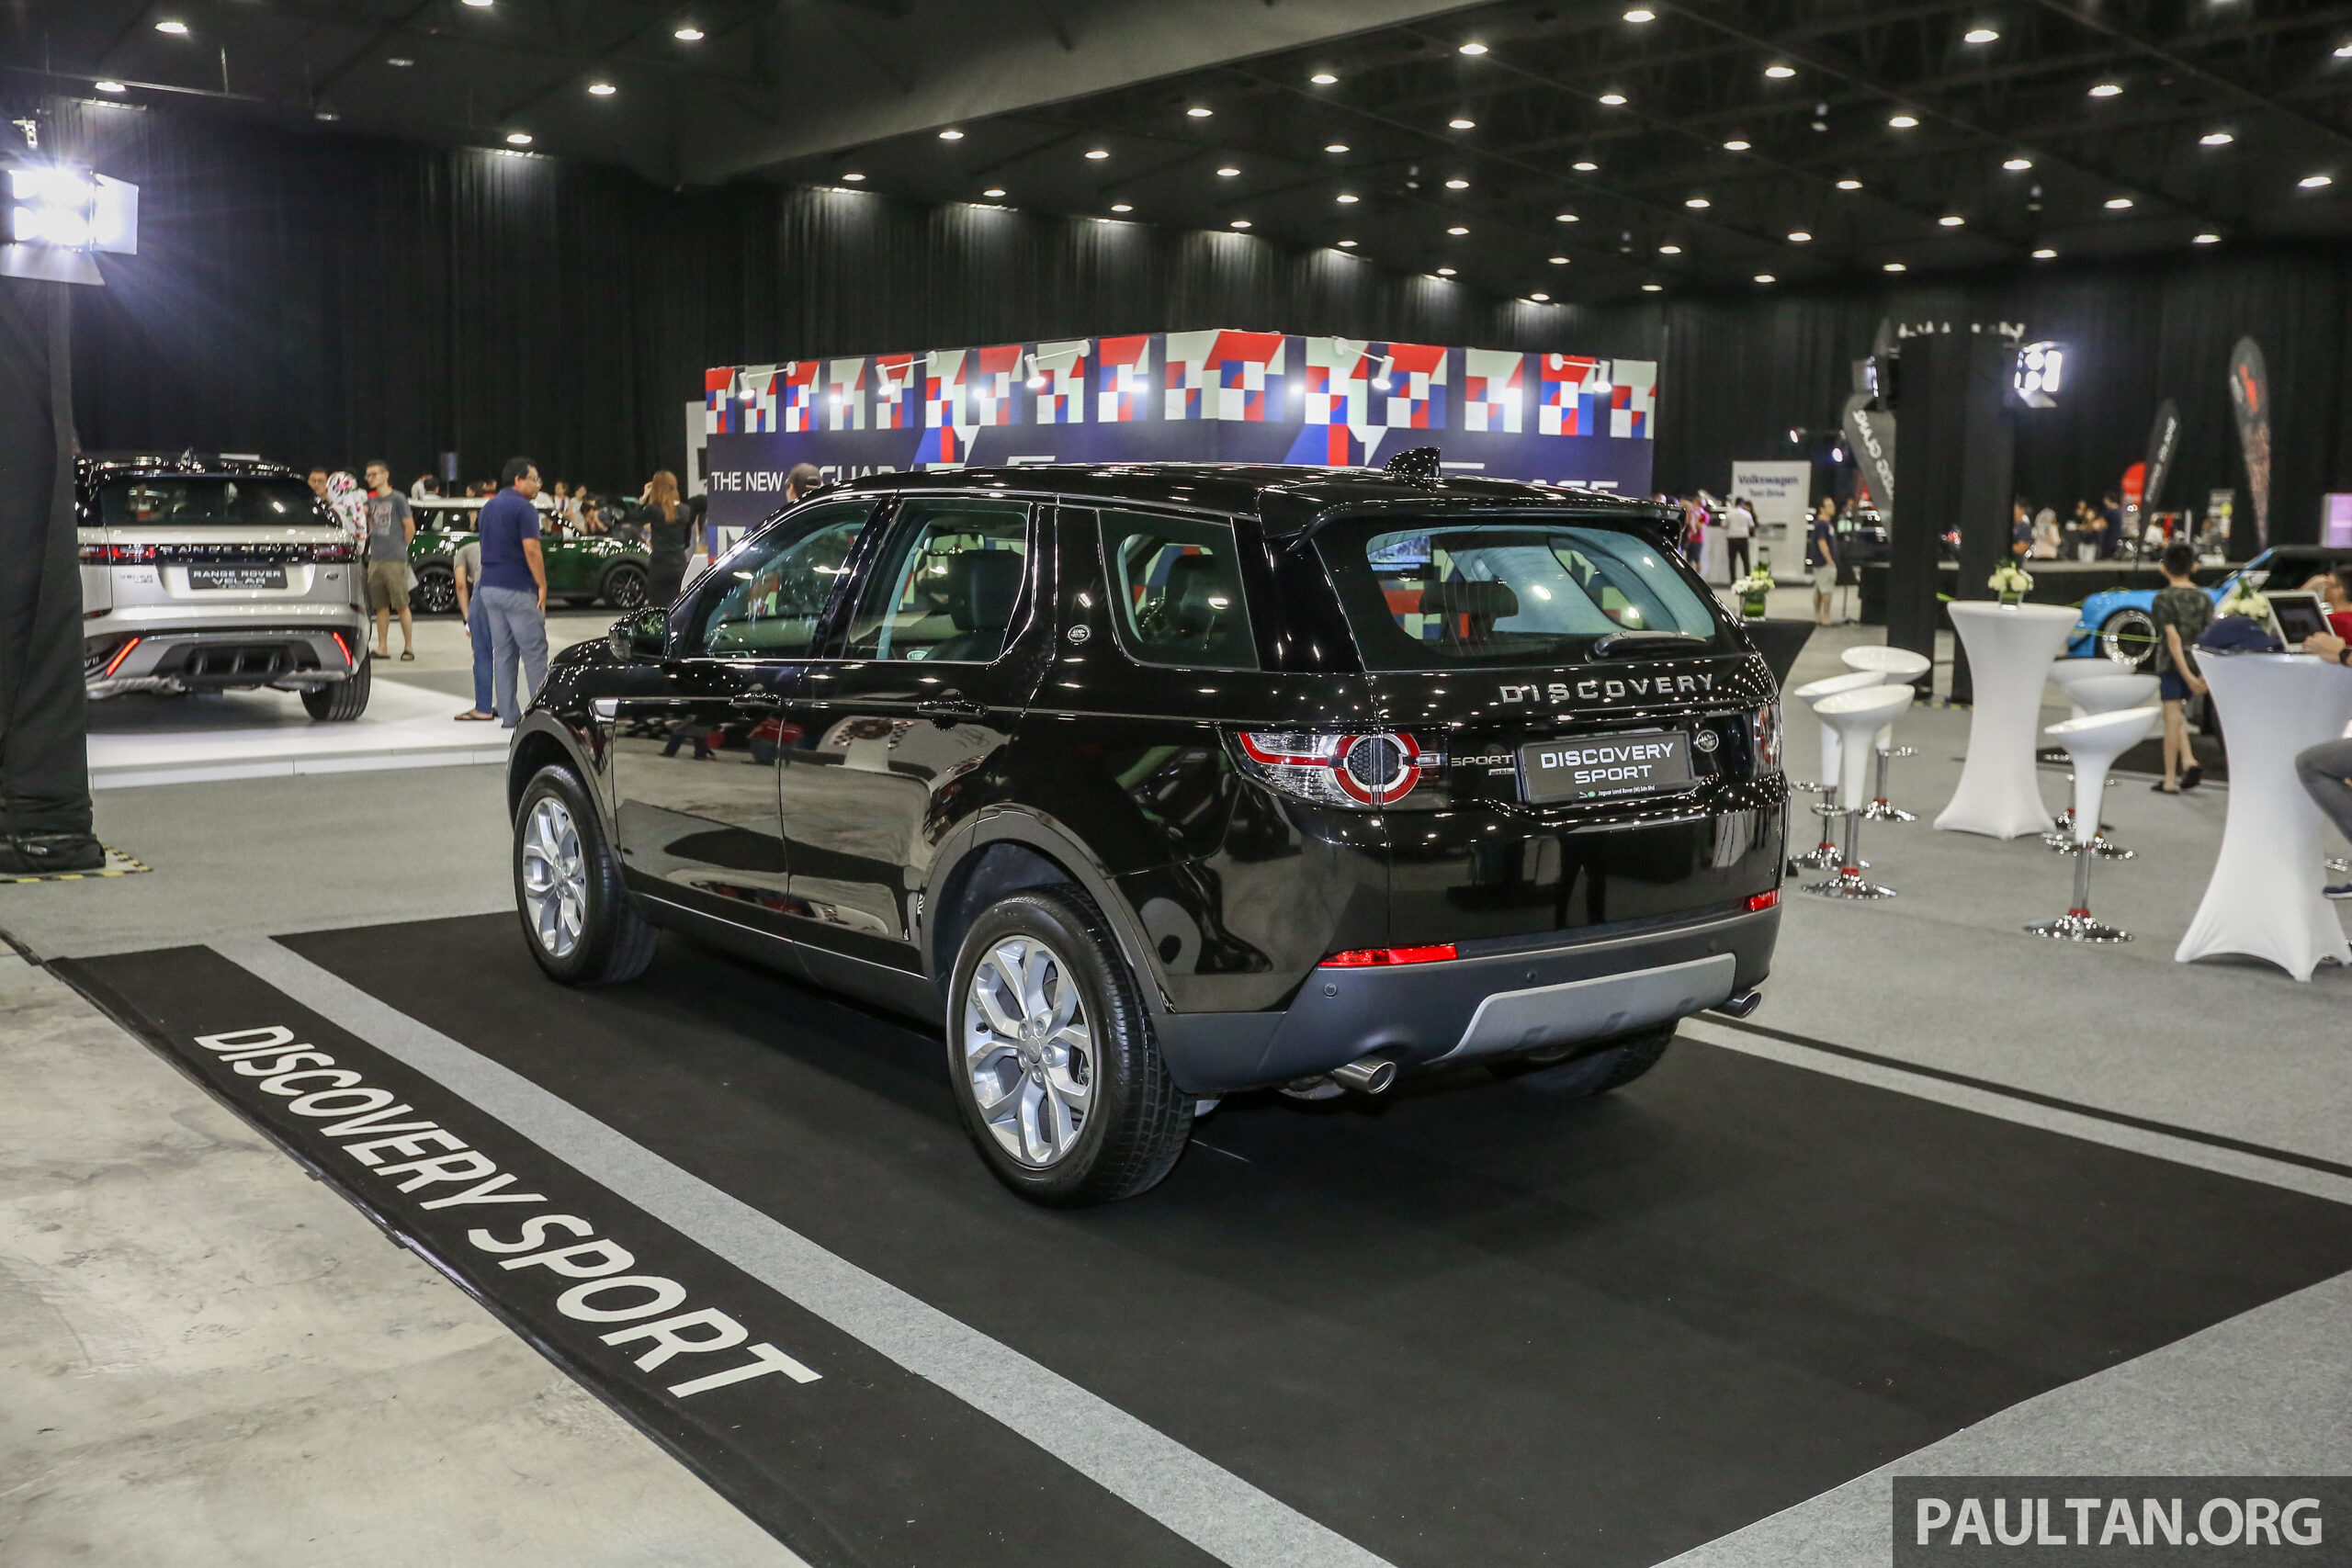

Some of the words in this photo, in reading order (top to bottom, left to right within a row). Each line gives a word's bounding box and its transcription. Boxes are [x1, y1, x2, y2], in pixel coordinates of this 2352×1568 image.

[710, 471, 741, 491] THE
[745, 471, 784, 491] NEW
[1738, 474, 1799, 487] Volkswagen
[1499, 673, 1713, 703] DISCOVERY
[1451, 755, 1514, 767] SPORT
[1541, 742, 1675, 769] DISCOVERY
[1574, 764, 1653, 784] SPORT
[194, 1025, 548, 1210] DISCOVERY
[468, 1214, 823, 1398] SPORT
